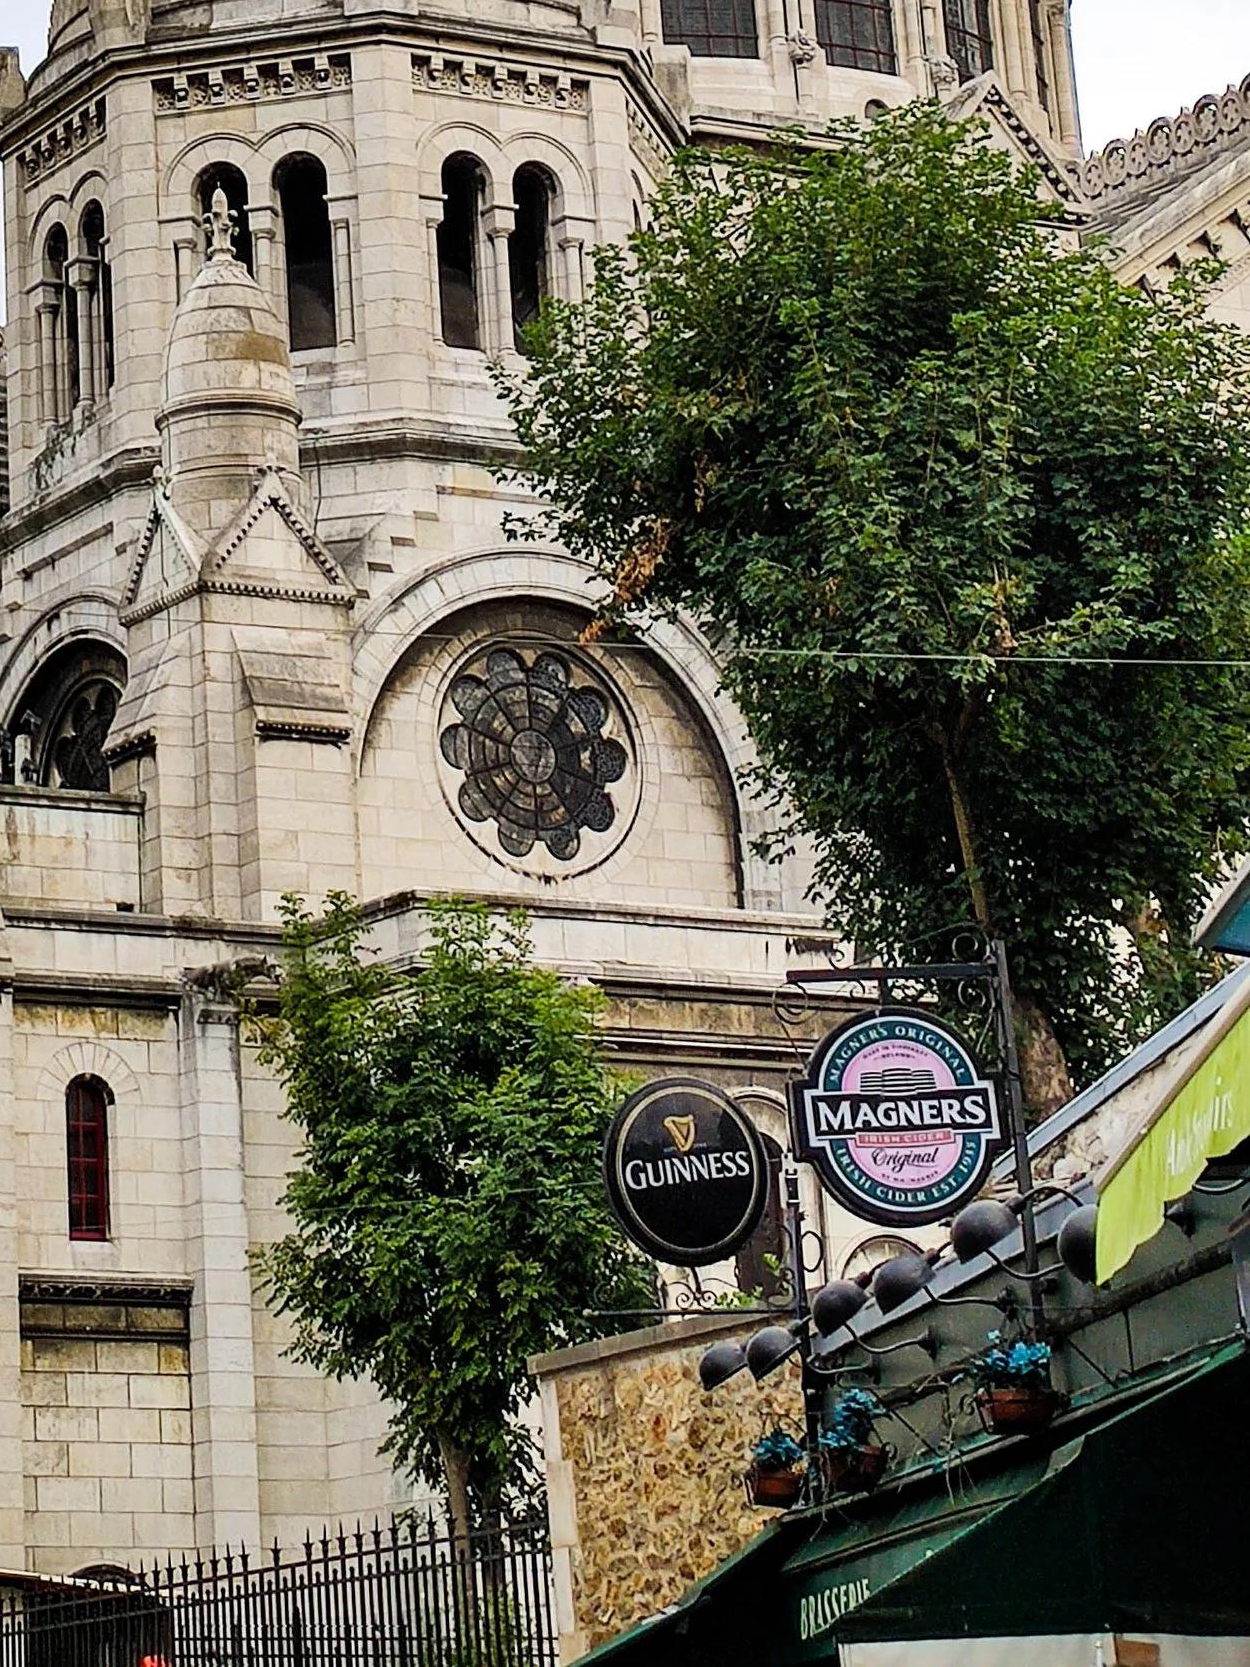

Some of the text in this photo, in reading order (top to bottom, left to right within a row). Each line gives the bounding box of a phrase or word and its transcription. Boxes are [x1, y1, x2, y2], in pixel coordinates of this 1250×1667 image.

[895, 1026, 967, 1078] ORIGINAL
[817, 1095, 987, 1132] MAGNERS
[865, 1133, 944, 1144] IRISH CIDER
[625, 1151, 749, 1190] GUINNESS
[836, 1147, 871, 1189] IRISH
[876, 1188, 927, 1203] CIDER
[871, 1147, 939, 1173] Original
